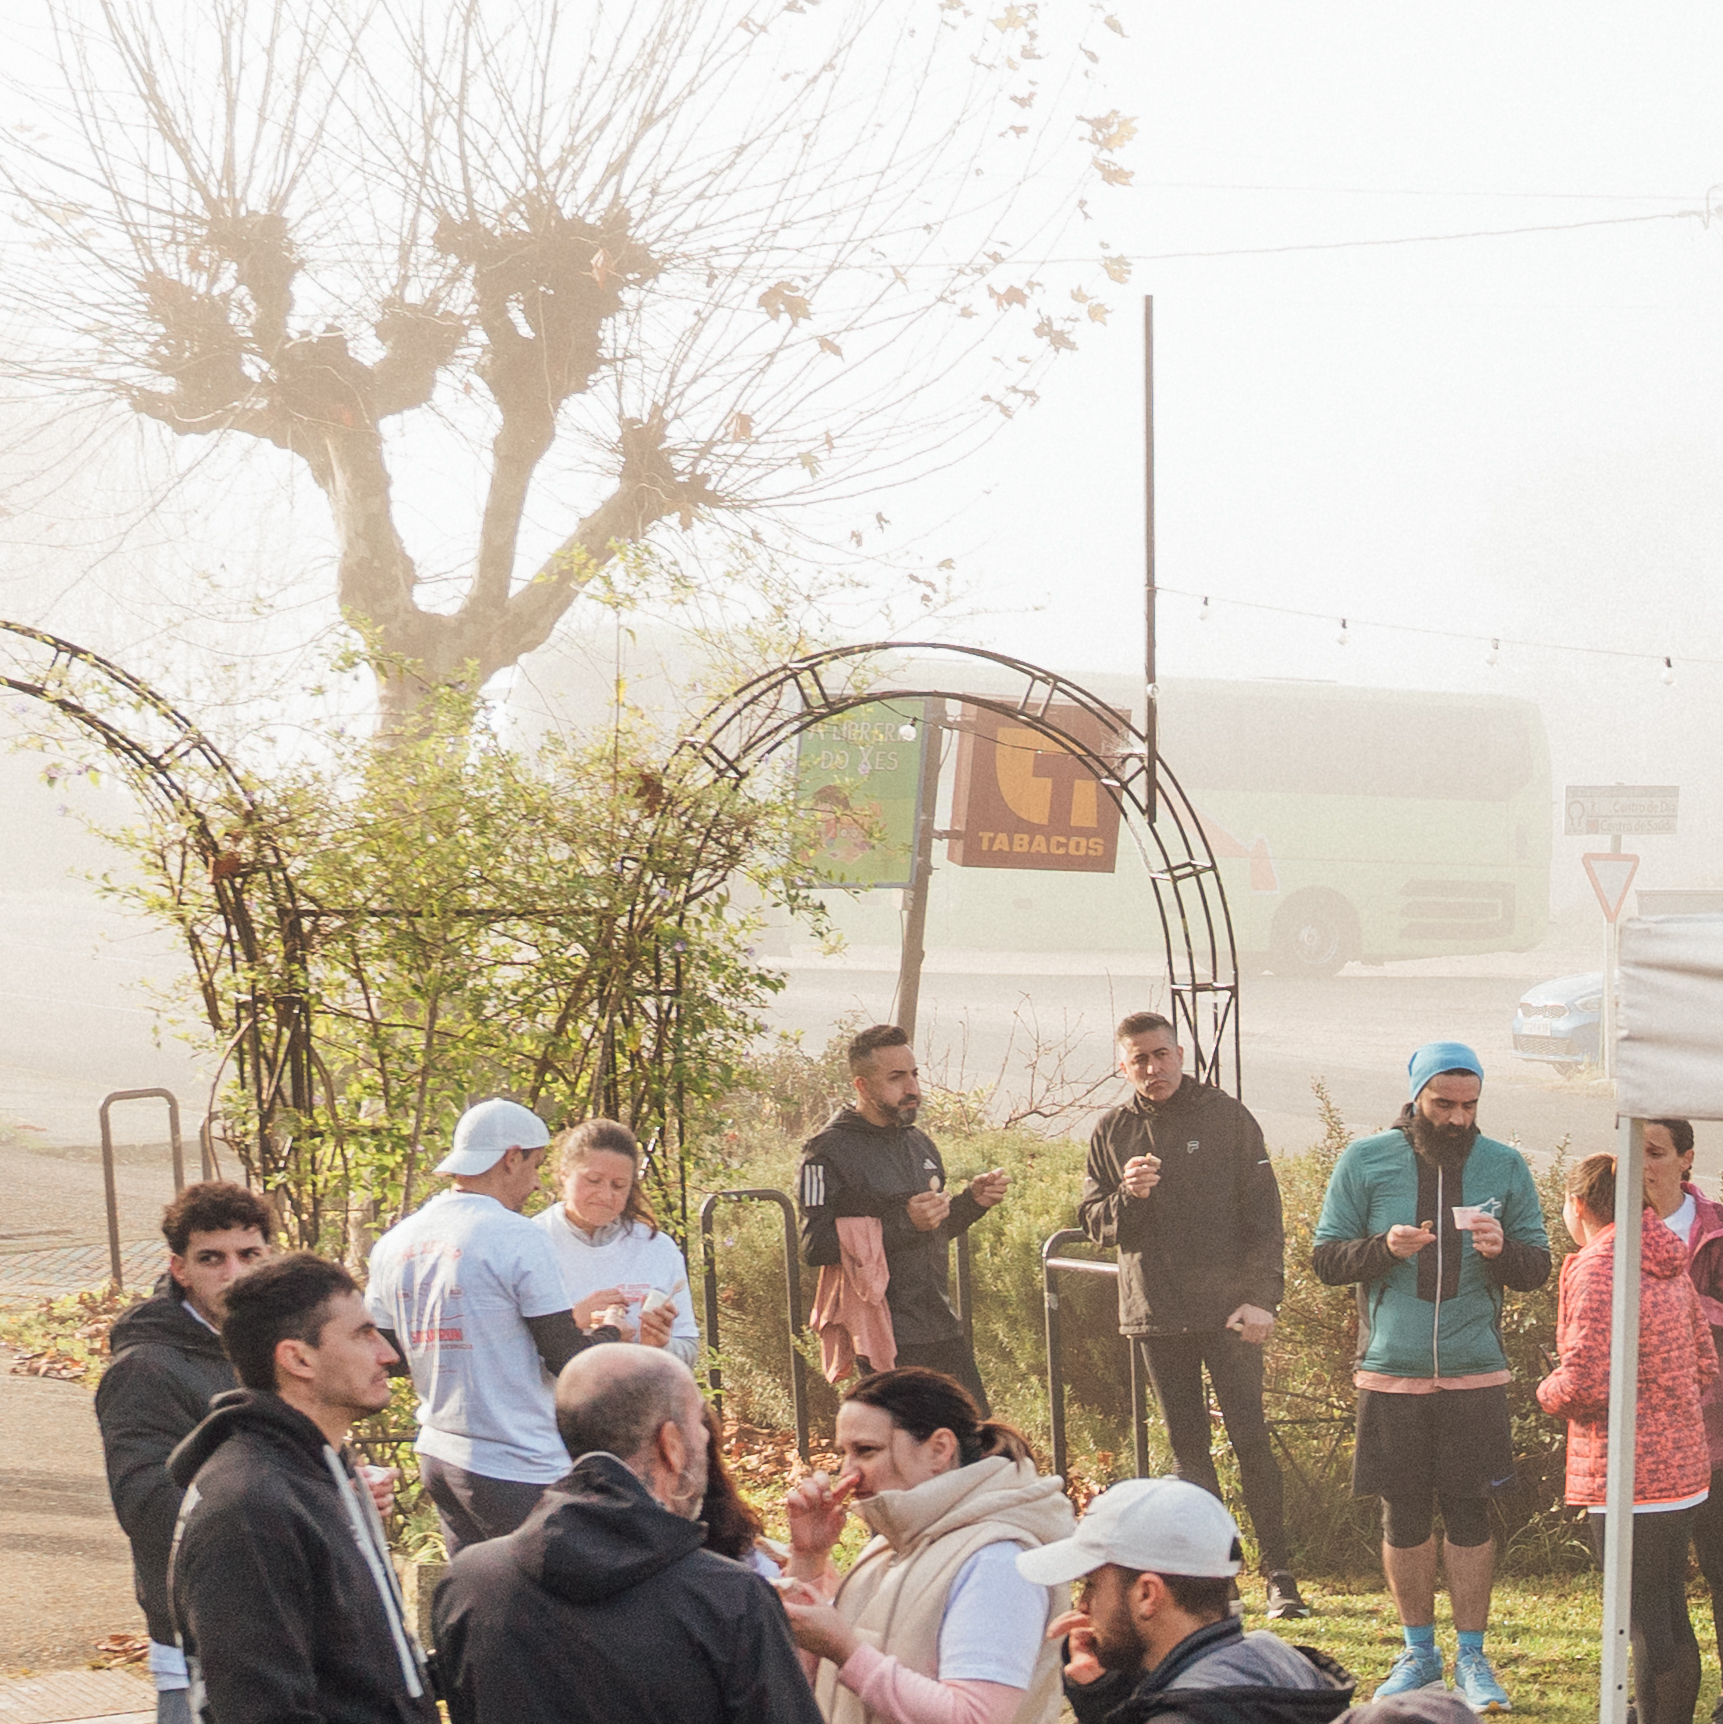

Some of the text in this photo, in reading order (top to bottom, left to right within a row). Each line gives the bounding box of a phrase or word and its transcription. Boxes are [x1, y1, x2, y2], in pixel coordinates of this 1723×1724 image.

[1613, 801, 1645, 813] Centro
[1647, 801, 1658, 813] de
[1600, 820, 1632, 832] Centro
[1634, 820, 1646, 832] de
[979, 831, 1104, 857] TABACOS
